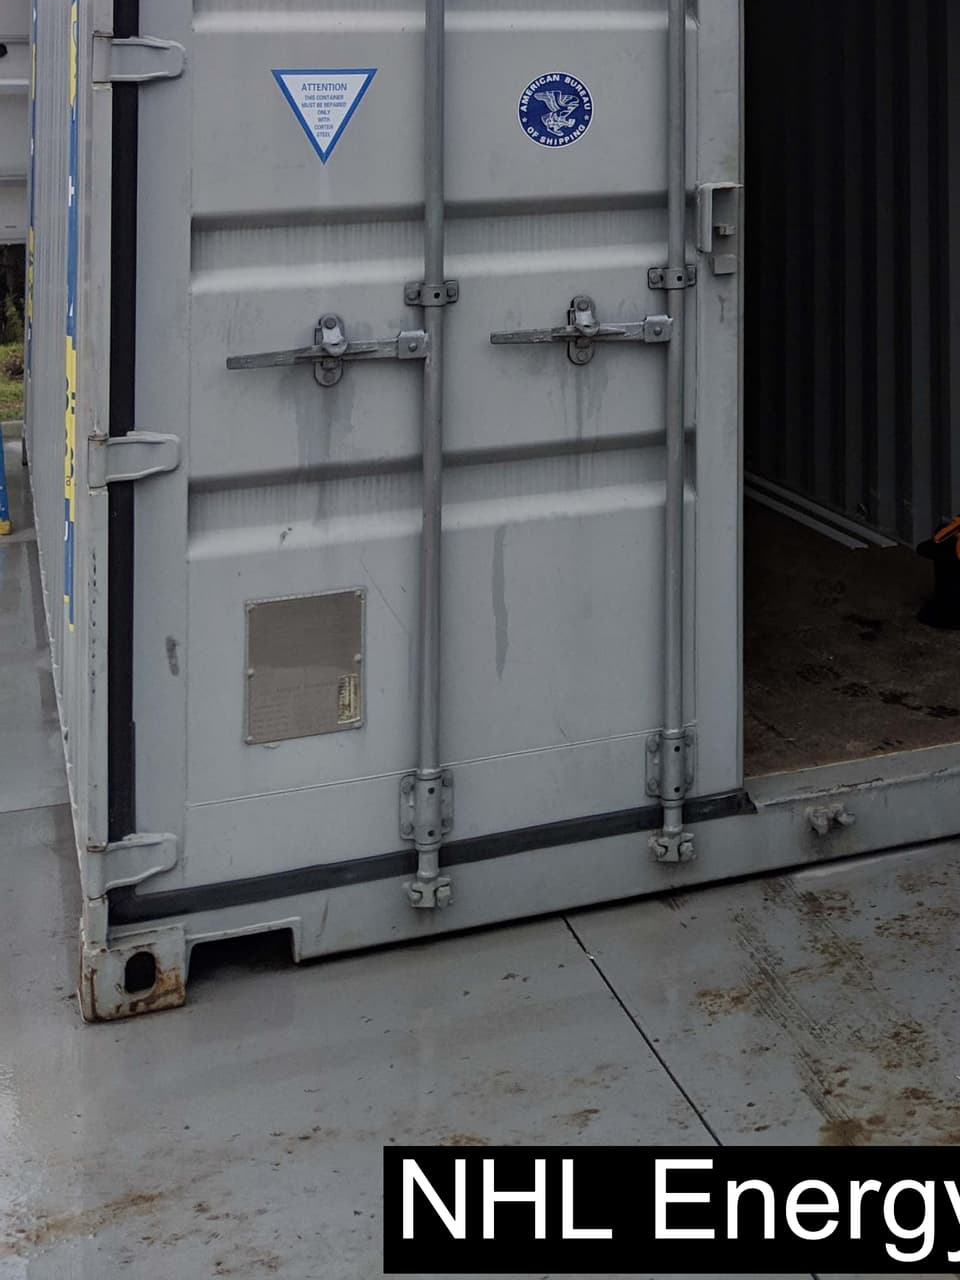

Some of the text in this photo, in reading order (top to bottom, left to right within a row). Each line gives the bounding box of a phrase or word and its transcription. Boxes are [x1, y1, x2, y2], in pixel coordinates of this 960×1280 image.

[301, 83, 347, 91] ATTENTION
[520, 74, 591, 112] AMERICAN BUREAU
[526, 124, 586, 146] OF SHIPPING
